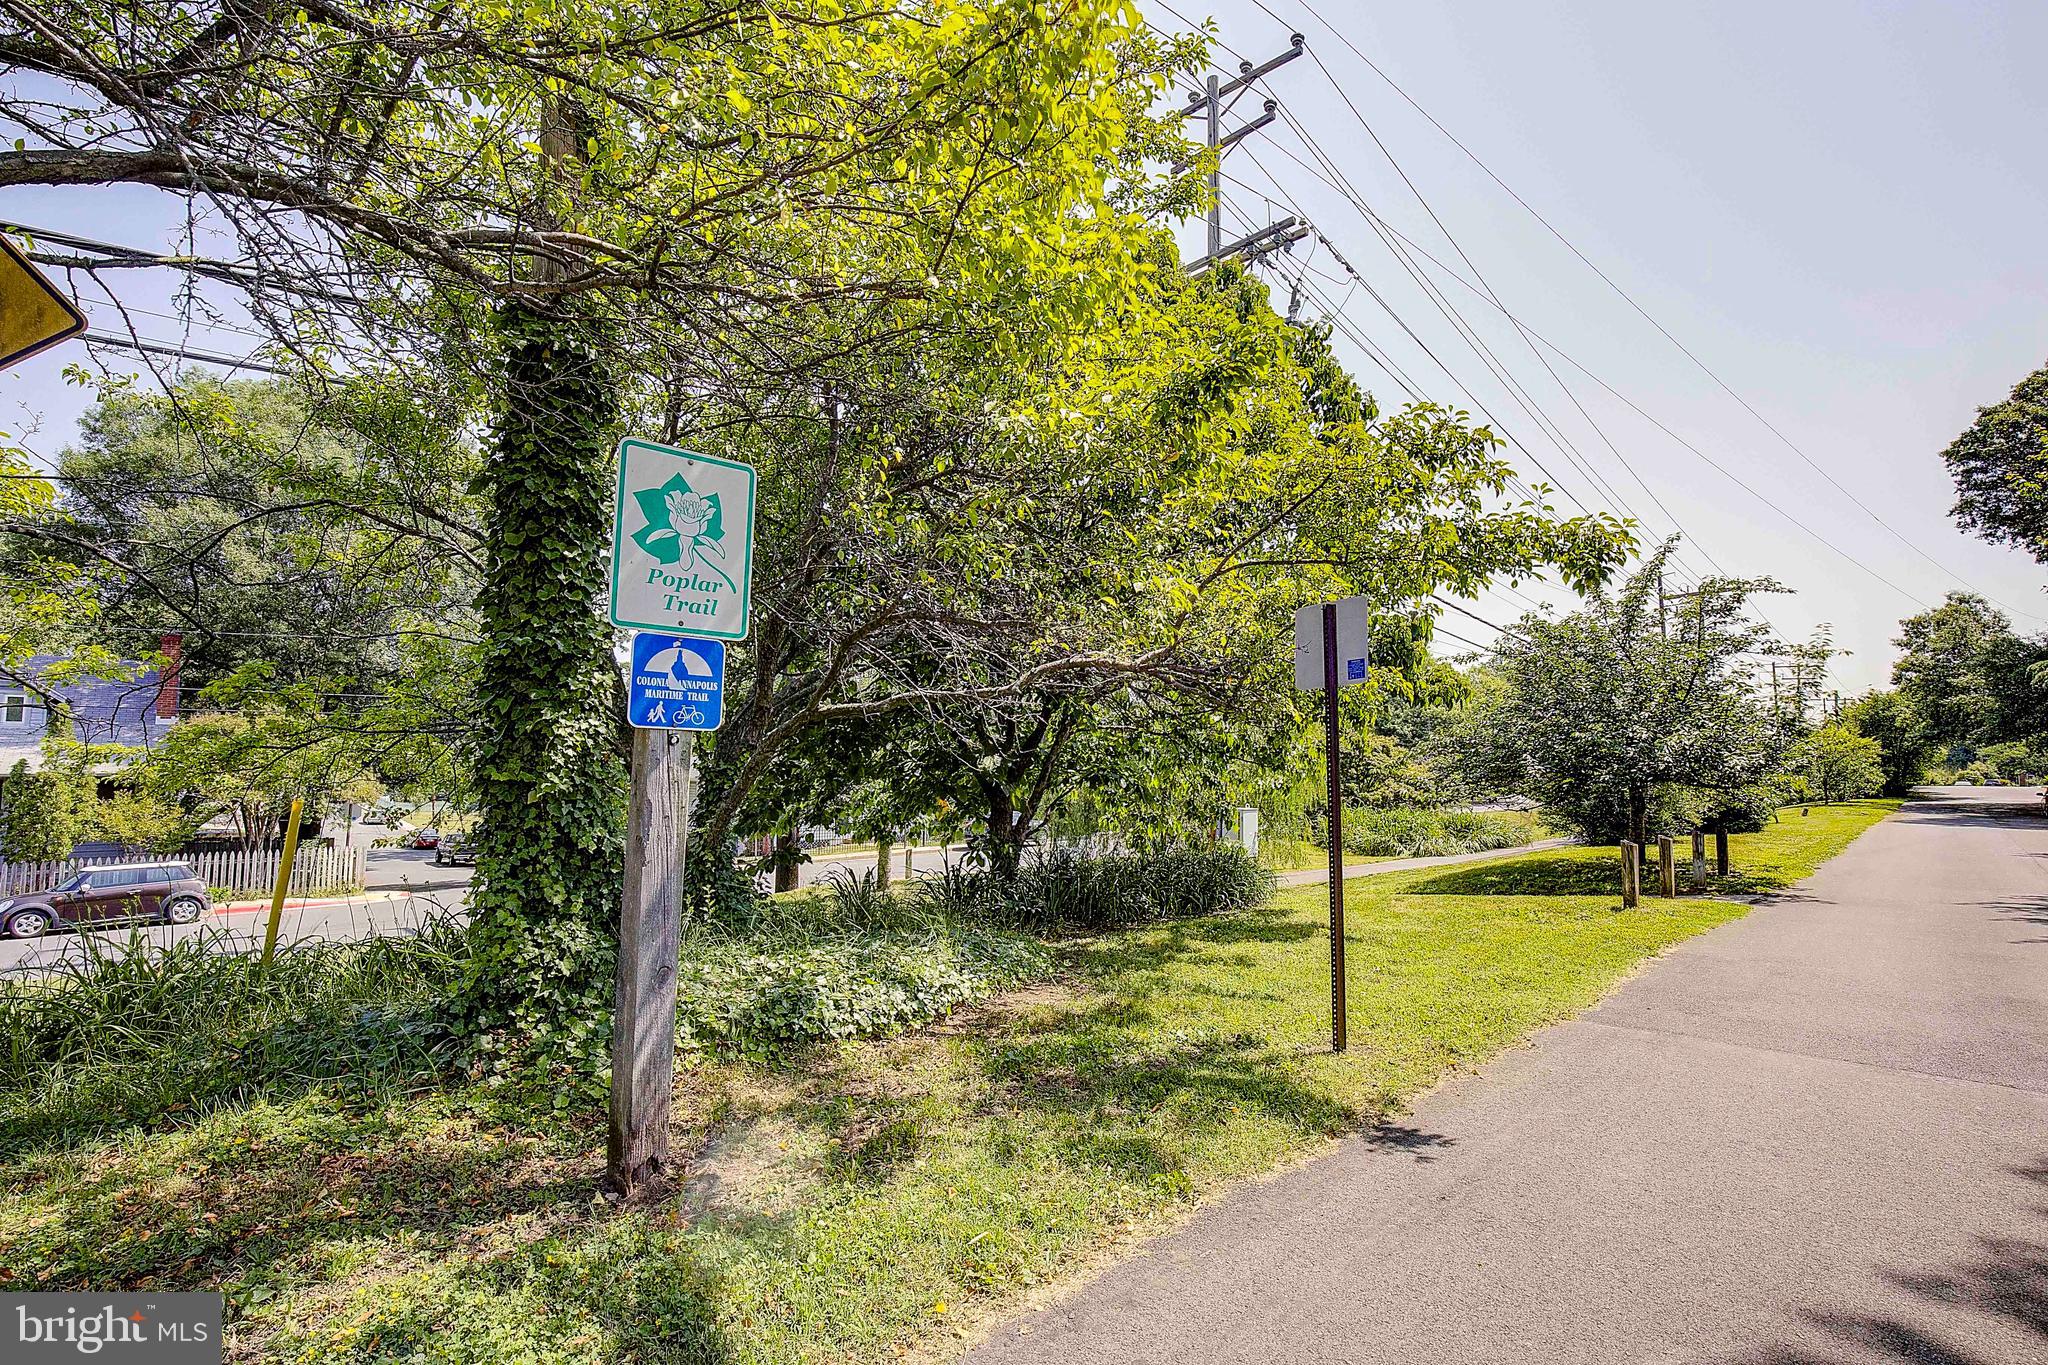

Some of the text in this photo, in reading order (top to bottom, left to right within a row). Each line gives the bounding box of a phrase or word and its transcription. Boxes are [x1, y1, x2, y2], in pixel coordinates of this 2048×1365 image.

[645, 568, 723, 593] Poplar
[663, 594, 719, 616] Trail
[636, 675, 670, 688] COLONIA
[644, 688, 710, 702] MARITIME TRAIL
